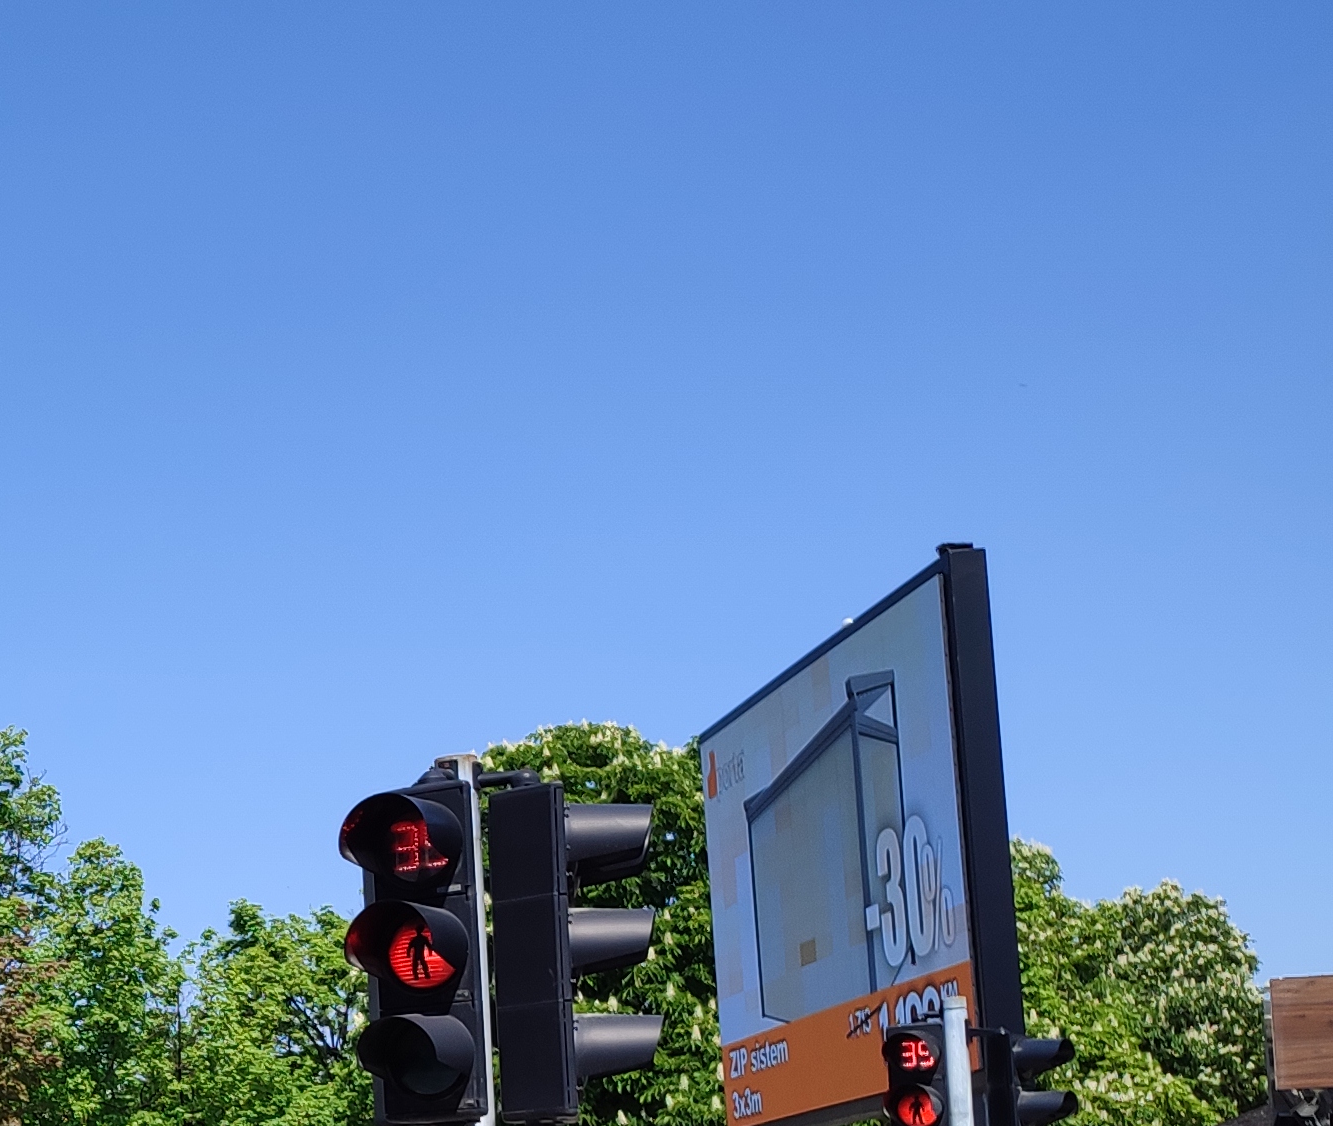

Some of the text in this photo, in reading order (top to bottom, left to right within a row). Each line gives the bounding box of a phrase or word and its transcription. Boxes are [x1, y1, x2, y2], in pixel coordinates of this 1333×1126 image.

[866, 815, 955, 966] -30%
[730, 1040, 789, 1078] ZIP sistem
[733, 1087, 763, 1119] 3x3m
